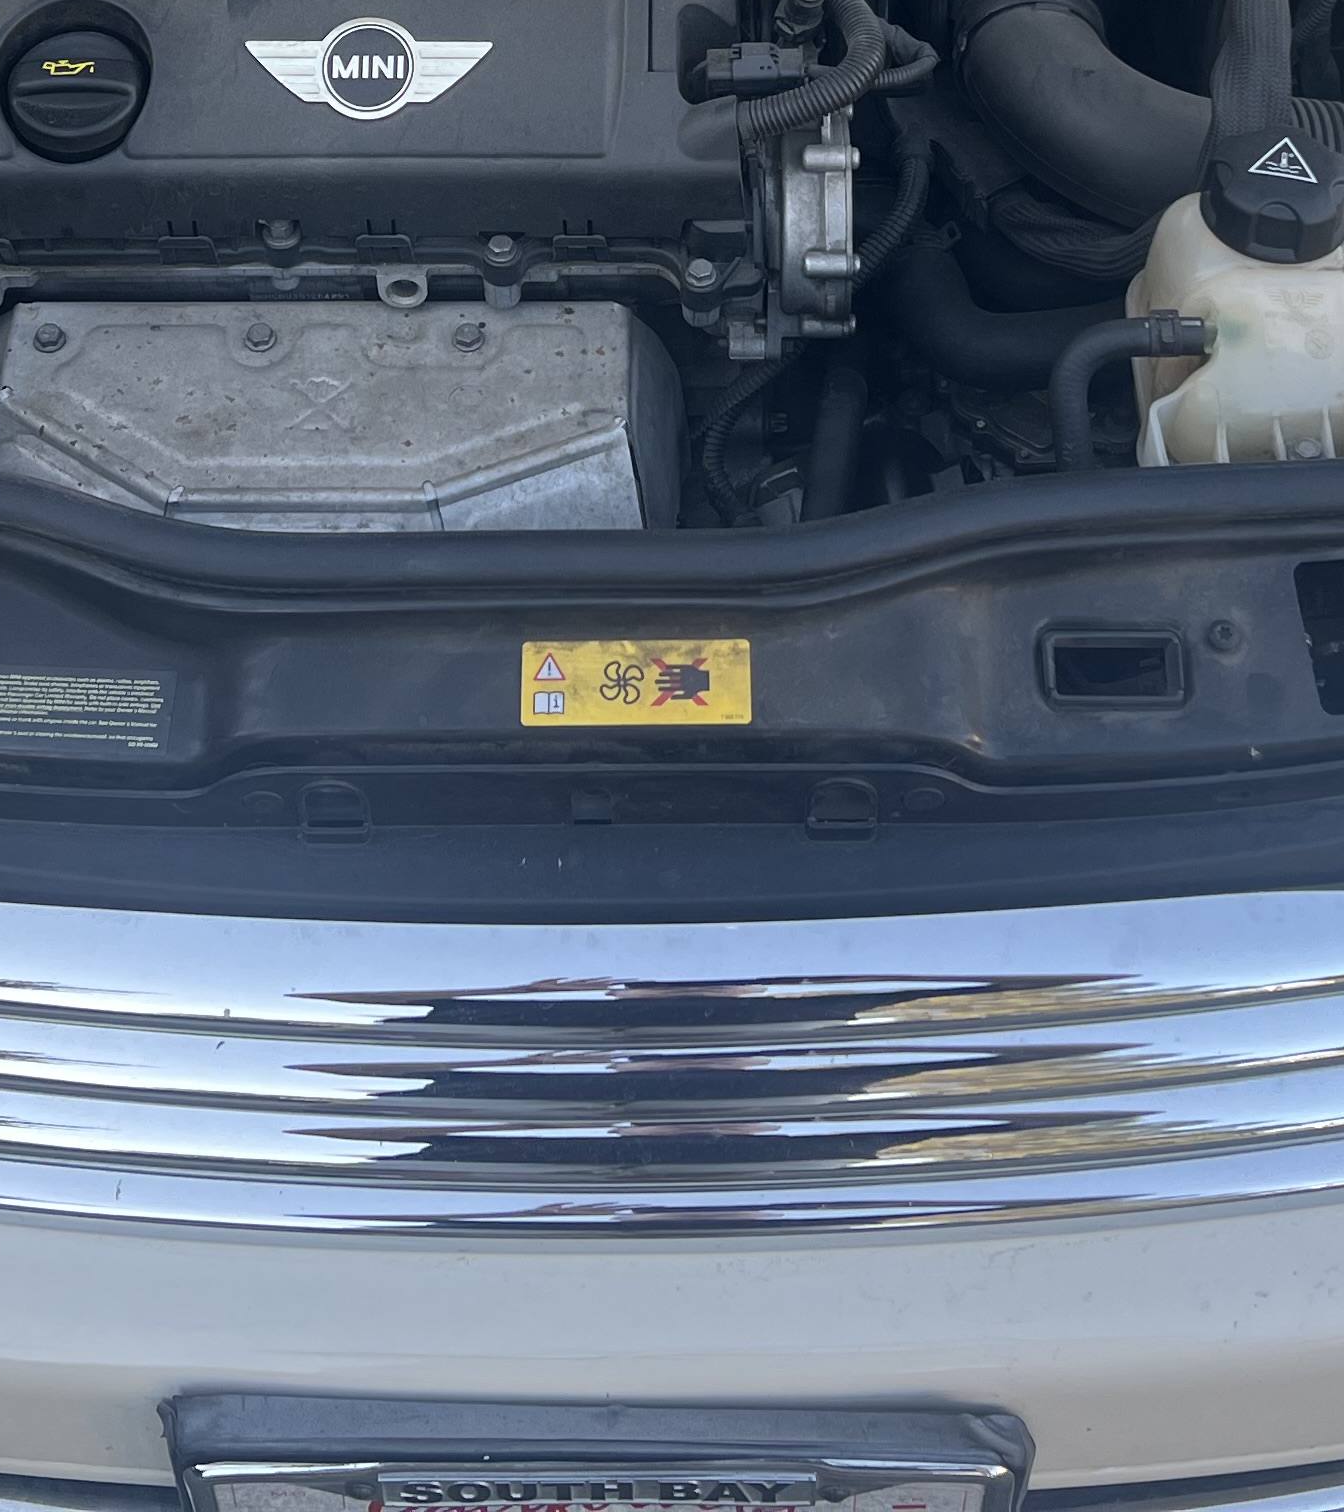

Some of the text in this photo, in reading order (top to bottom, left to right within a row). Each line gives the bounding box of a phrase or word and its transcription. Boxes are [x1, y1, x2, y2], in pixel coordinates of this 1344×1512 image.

[331, 54, 406, 80] MINI
[399, 1479, 796, 1504] SOUTH BAY
